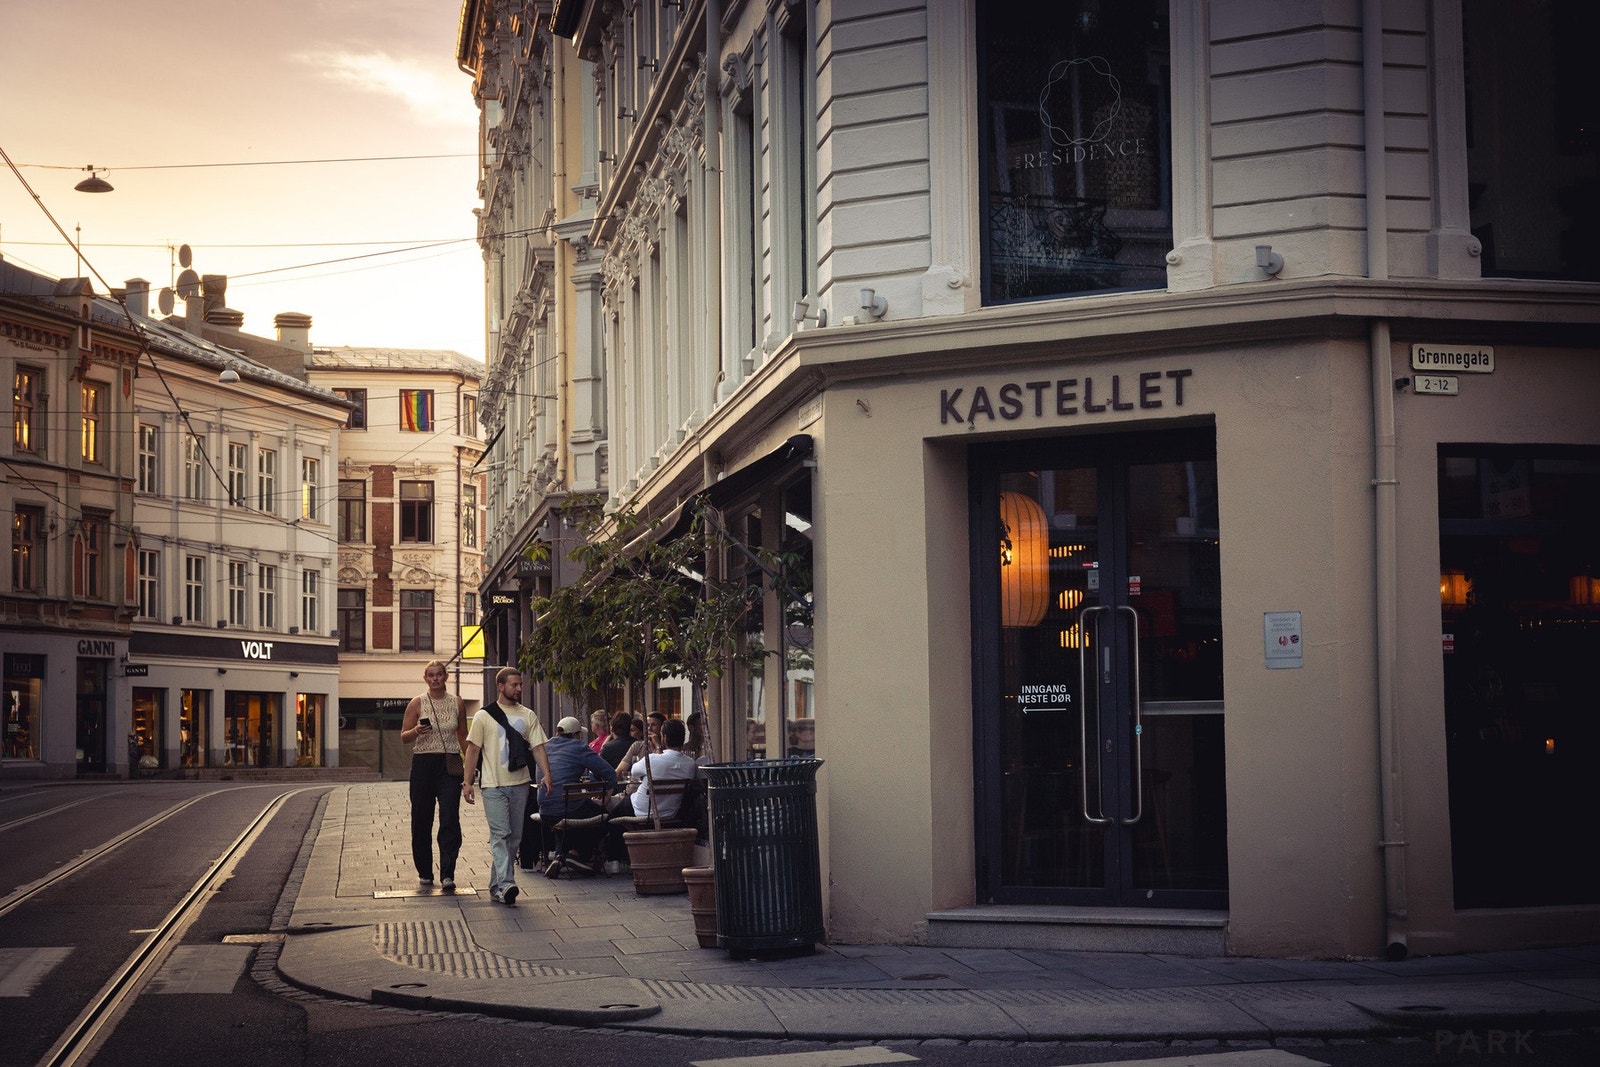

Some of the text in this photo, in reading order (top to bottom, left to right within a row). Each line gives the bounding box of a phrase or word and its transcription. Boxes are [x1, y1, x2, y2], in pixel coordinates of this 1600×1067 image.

[1418, 347, 1489, 369] Grønnegata
[940, 369, 1192, 424] KASTELLET
[77, 639, 115, 656] GANNI
[241, 641, 273, 660] VOLT
[1021, 684, 1067, 694] INNGANG
[1017, 694, 1071, 704] NESTE DØR
